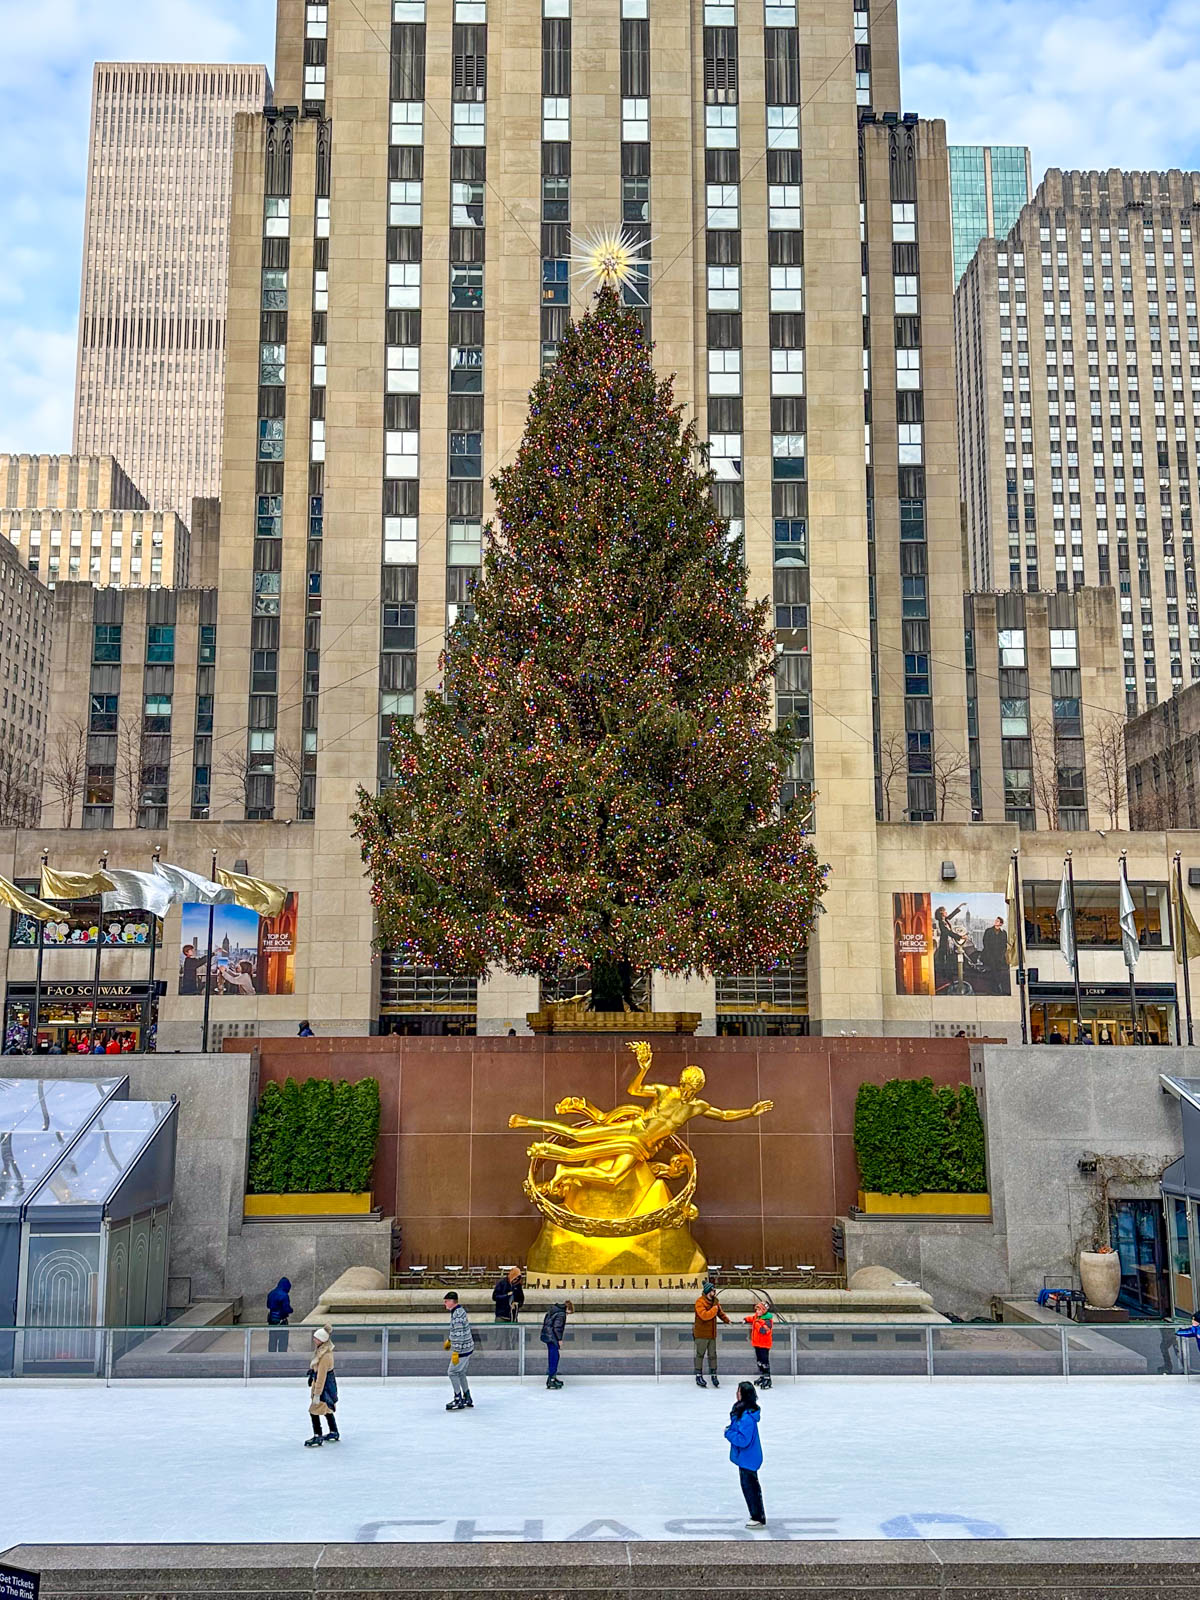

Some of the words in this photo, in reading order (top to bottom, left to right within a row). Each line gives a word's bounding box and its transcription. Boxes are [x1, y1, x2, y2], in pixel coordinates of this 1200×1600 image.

[355, 1517, 841, 1542] CHASE
[0, 1573, 11, 1584] Get
[12, 1575, 35, 1590] Tickets
[6, 1585, 19, 1597] The
[19, 1588, 34, 1600] Rink
